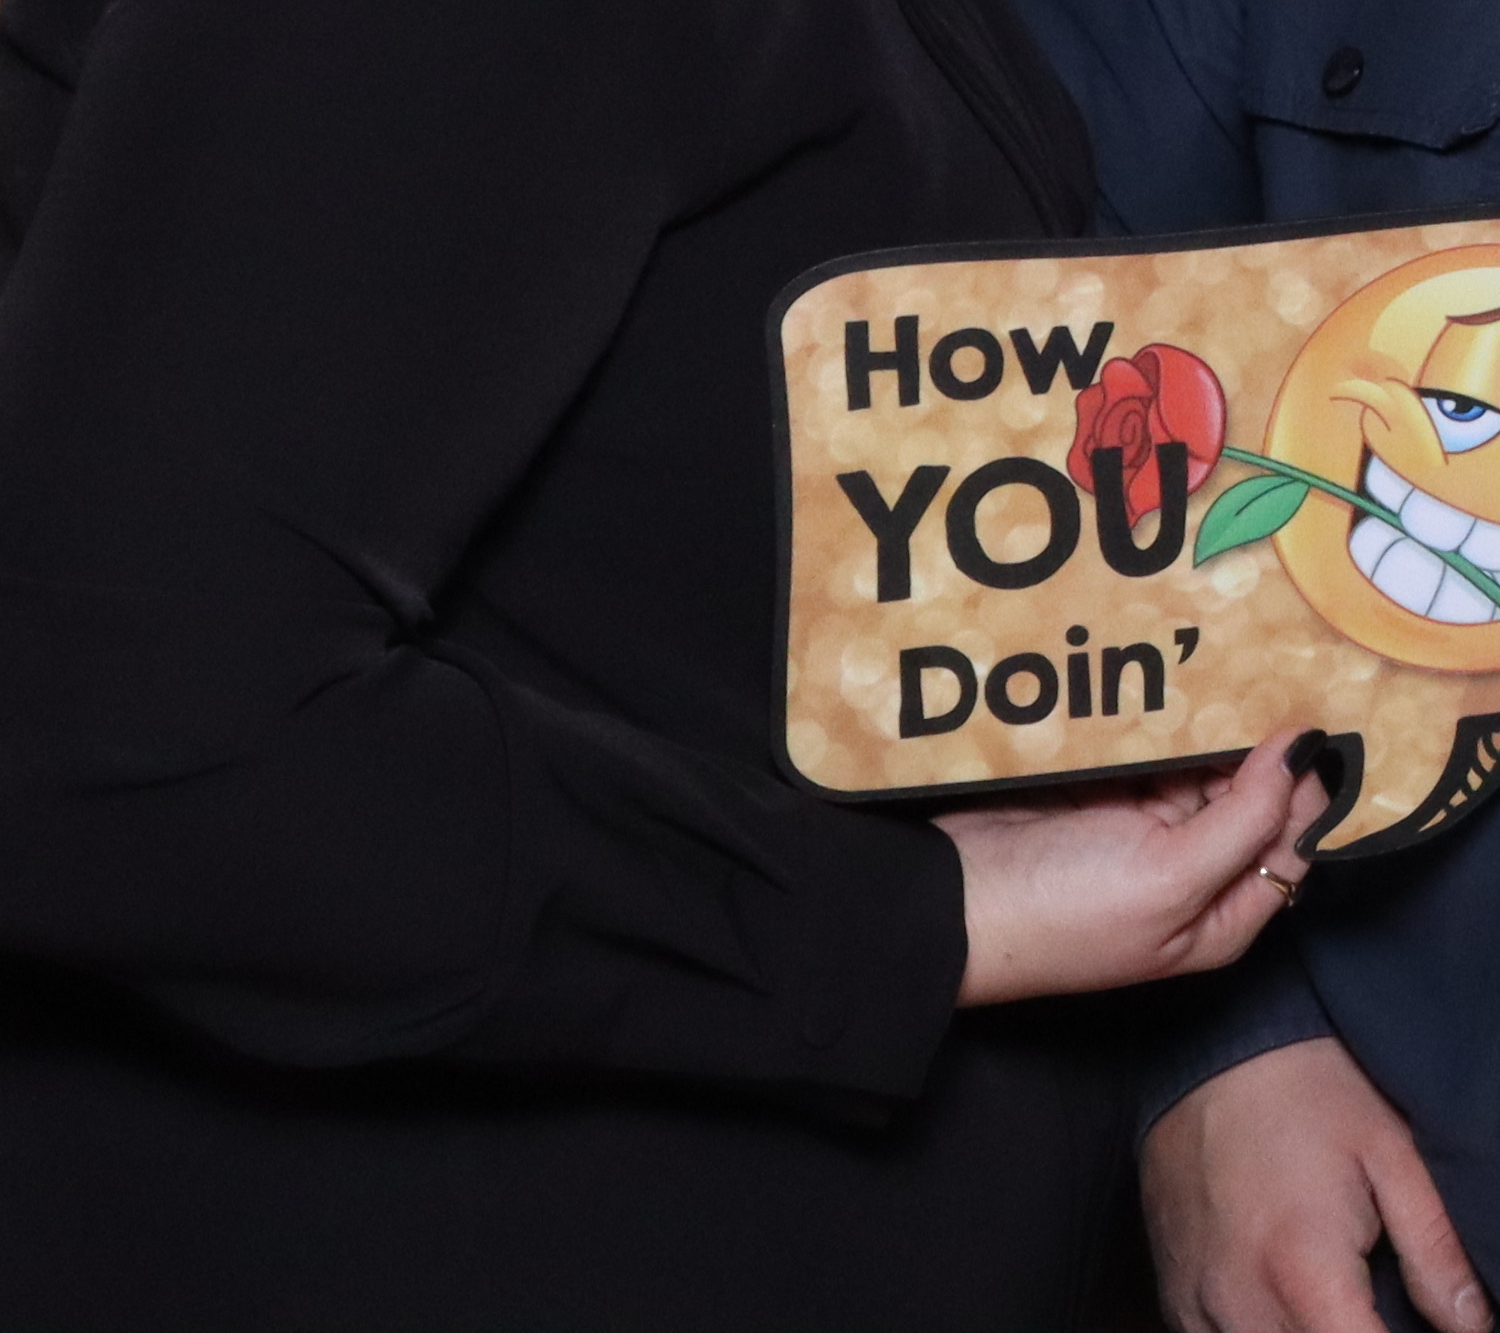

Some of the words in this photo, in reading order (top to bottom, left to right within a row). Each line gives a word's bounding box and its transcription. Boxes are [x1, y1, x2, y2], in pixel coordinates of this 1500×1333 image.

[844, 314, 1115, 410] How
[836, 441, 1189, 603] YOU
[898, 625, 1200, 739] Doin’
